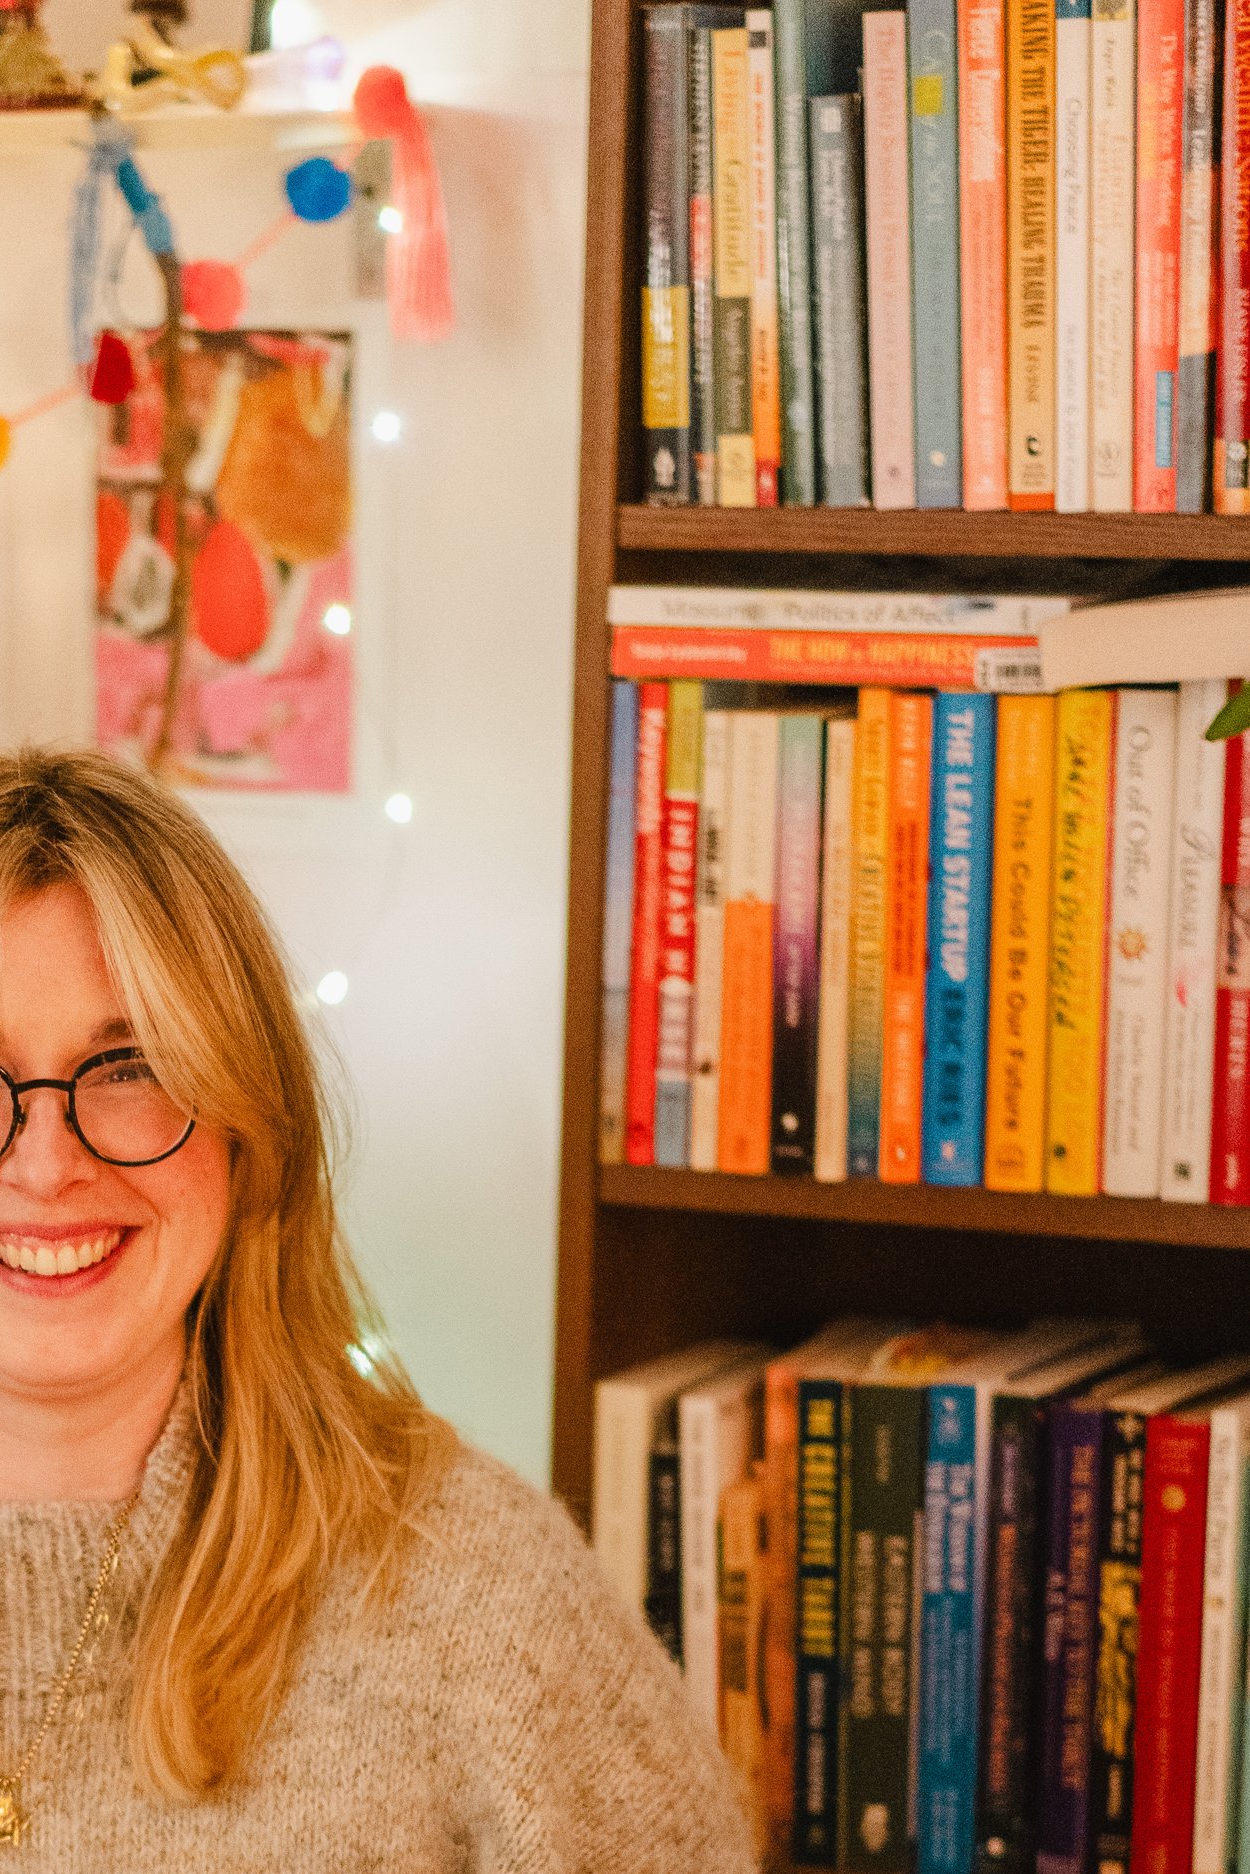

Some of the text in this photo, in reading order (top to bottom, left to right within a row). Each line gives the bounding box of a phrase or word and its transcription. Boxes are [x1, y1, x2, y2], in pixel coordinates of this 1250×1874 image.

[1021, 66, 1045, 100] THE
[1021, 106, 1048, 171] TIGER:
[1062, 99, 1083, 234] Choosing Peace
[722, 158, 746, 281] Gratitude
[924, 163, 947, 224] SOUL
[1021, 176, 1048, 249] HEALING
[1023, 255, 1046, 328] TRAUMA
[769, 637, 803, 660] THE
[807, 638, 847, 662] HOW
[783, 601, 859, 624] Politics
[864, 601, 888, 624] of
[892, 601, 954, 625] Affect
[941, 710, 973, 982] THE LEAN STARTUP
[1123, 725, 1153, 901] Out of Office
[669, 808, 693, 937] INDIAN
[1004, 798, 1030, 1132] This Could Be Our Future
[938, 989, 965, 1127] ERIC RIES
